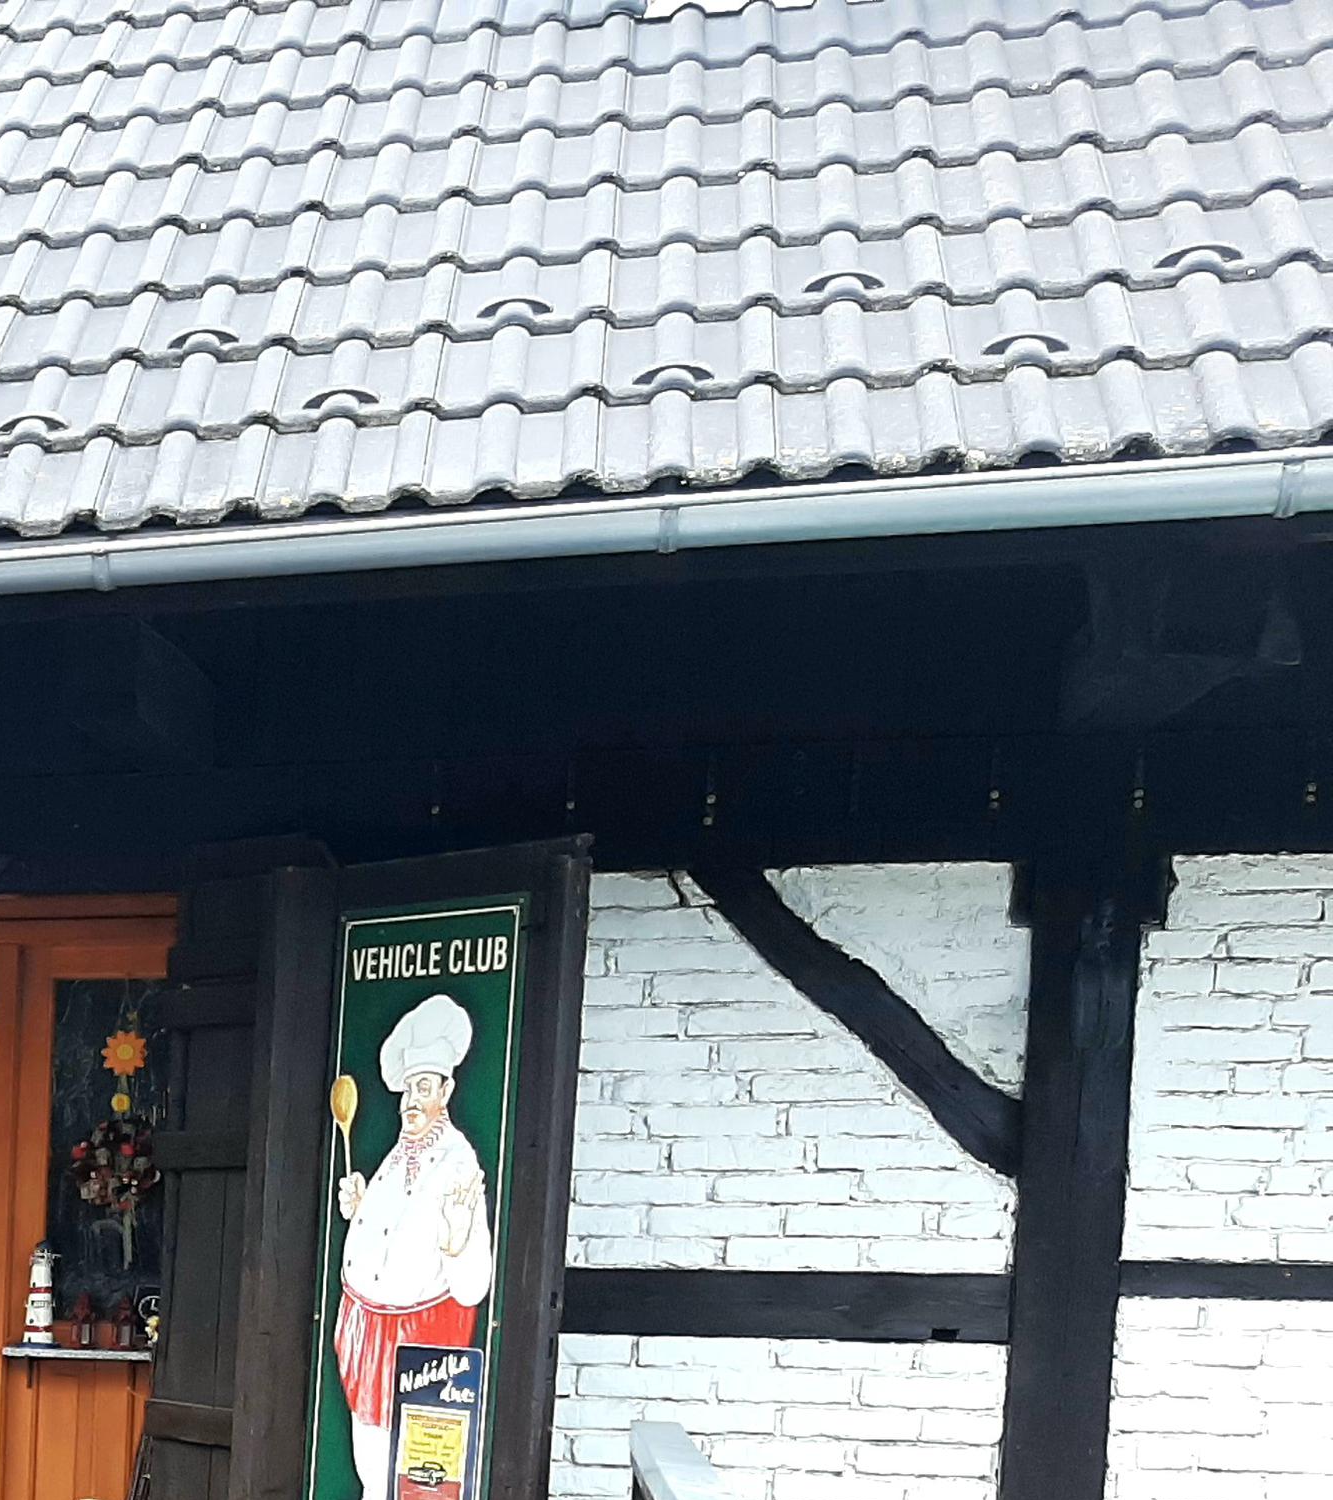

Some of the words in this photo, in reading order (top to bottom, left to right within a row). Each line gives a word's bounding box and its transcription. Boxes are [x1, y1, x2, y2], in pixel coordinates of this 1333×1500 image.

[352, 941, 443, 981] VEHICLE
[448, 936, 508, 974] CLUB
[399, 1353, 470, 1393] Nabídka
